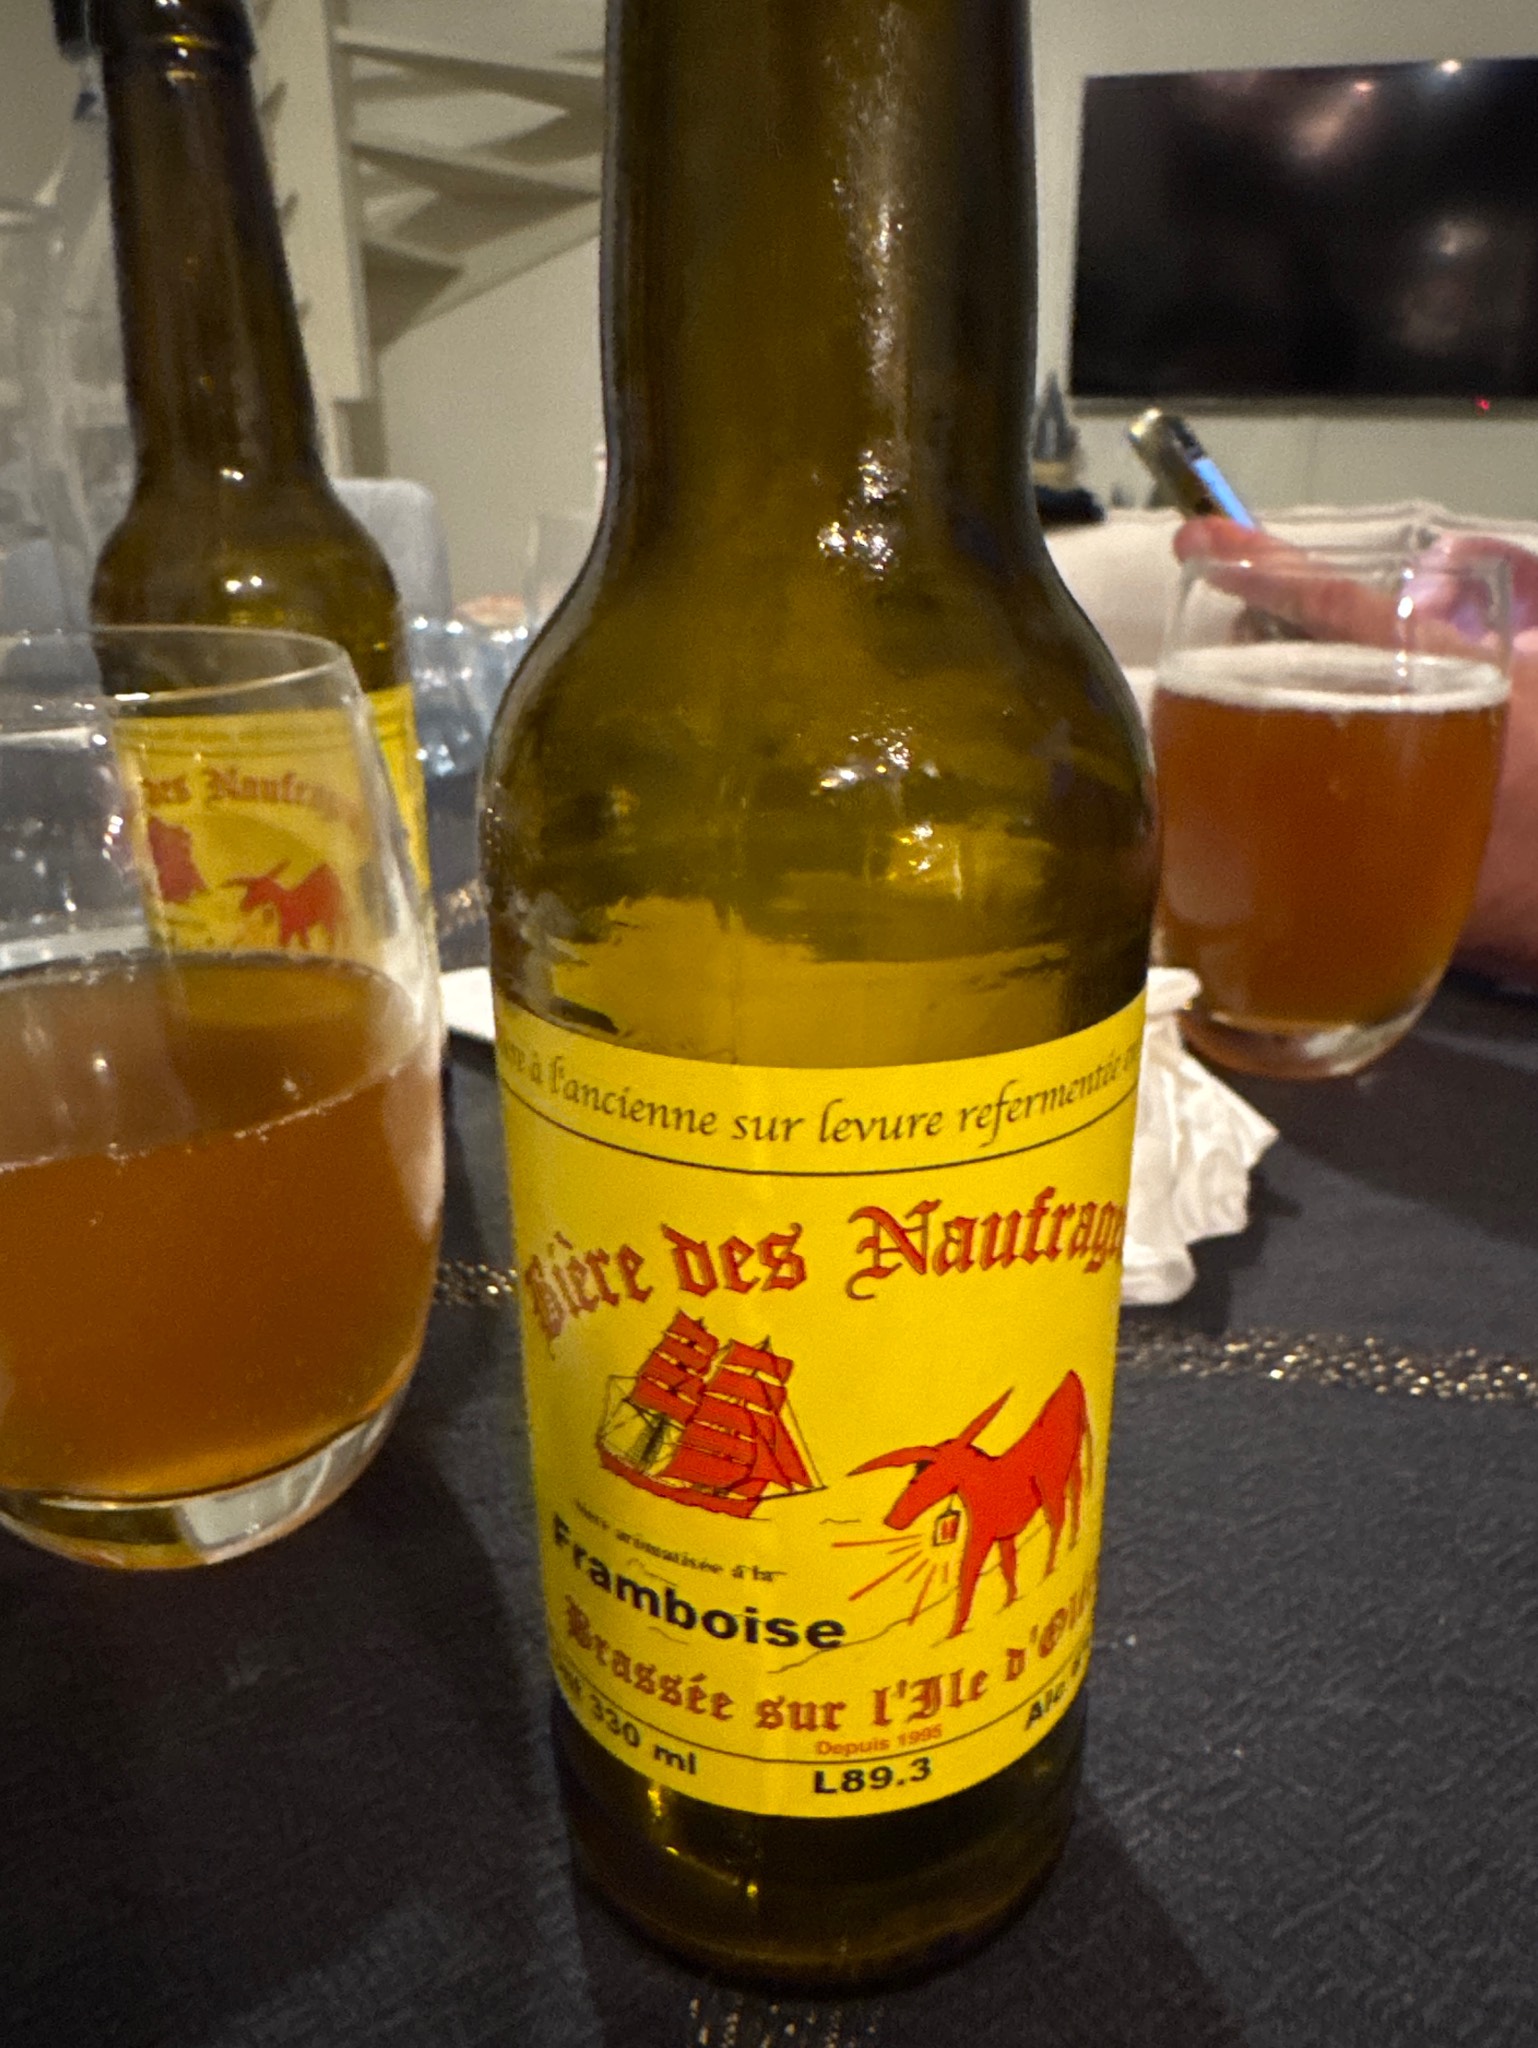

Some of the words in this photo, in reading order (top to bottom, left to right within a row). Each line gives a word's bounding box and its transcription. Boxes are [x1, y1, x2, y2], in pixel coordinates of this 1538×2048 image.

[550, 1055, 717, 1136] l'ancienne
[731, 1112, 806, 1143] sur
[818, 1098, 943, 1144] levure
[525, 1230, 654, 1343] Bière
[660, 1221, 807, 1298] des
[553, 1512, 847, 1650] Framboise
[565, 1595, 735, 1722] Brassée
[756, 1696, 847, 1732] sur
[589, 1694, 641, 1748] 330
[654, 1744, 697, 1775] ml
[813, 1756, 932, 1795] L89.3
[815, 1738, 891, 1757] Depuis
